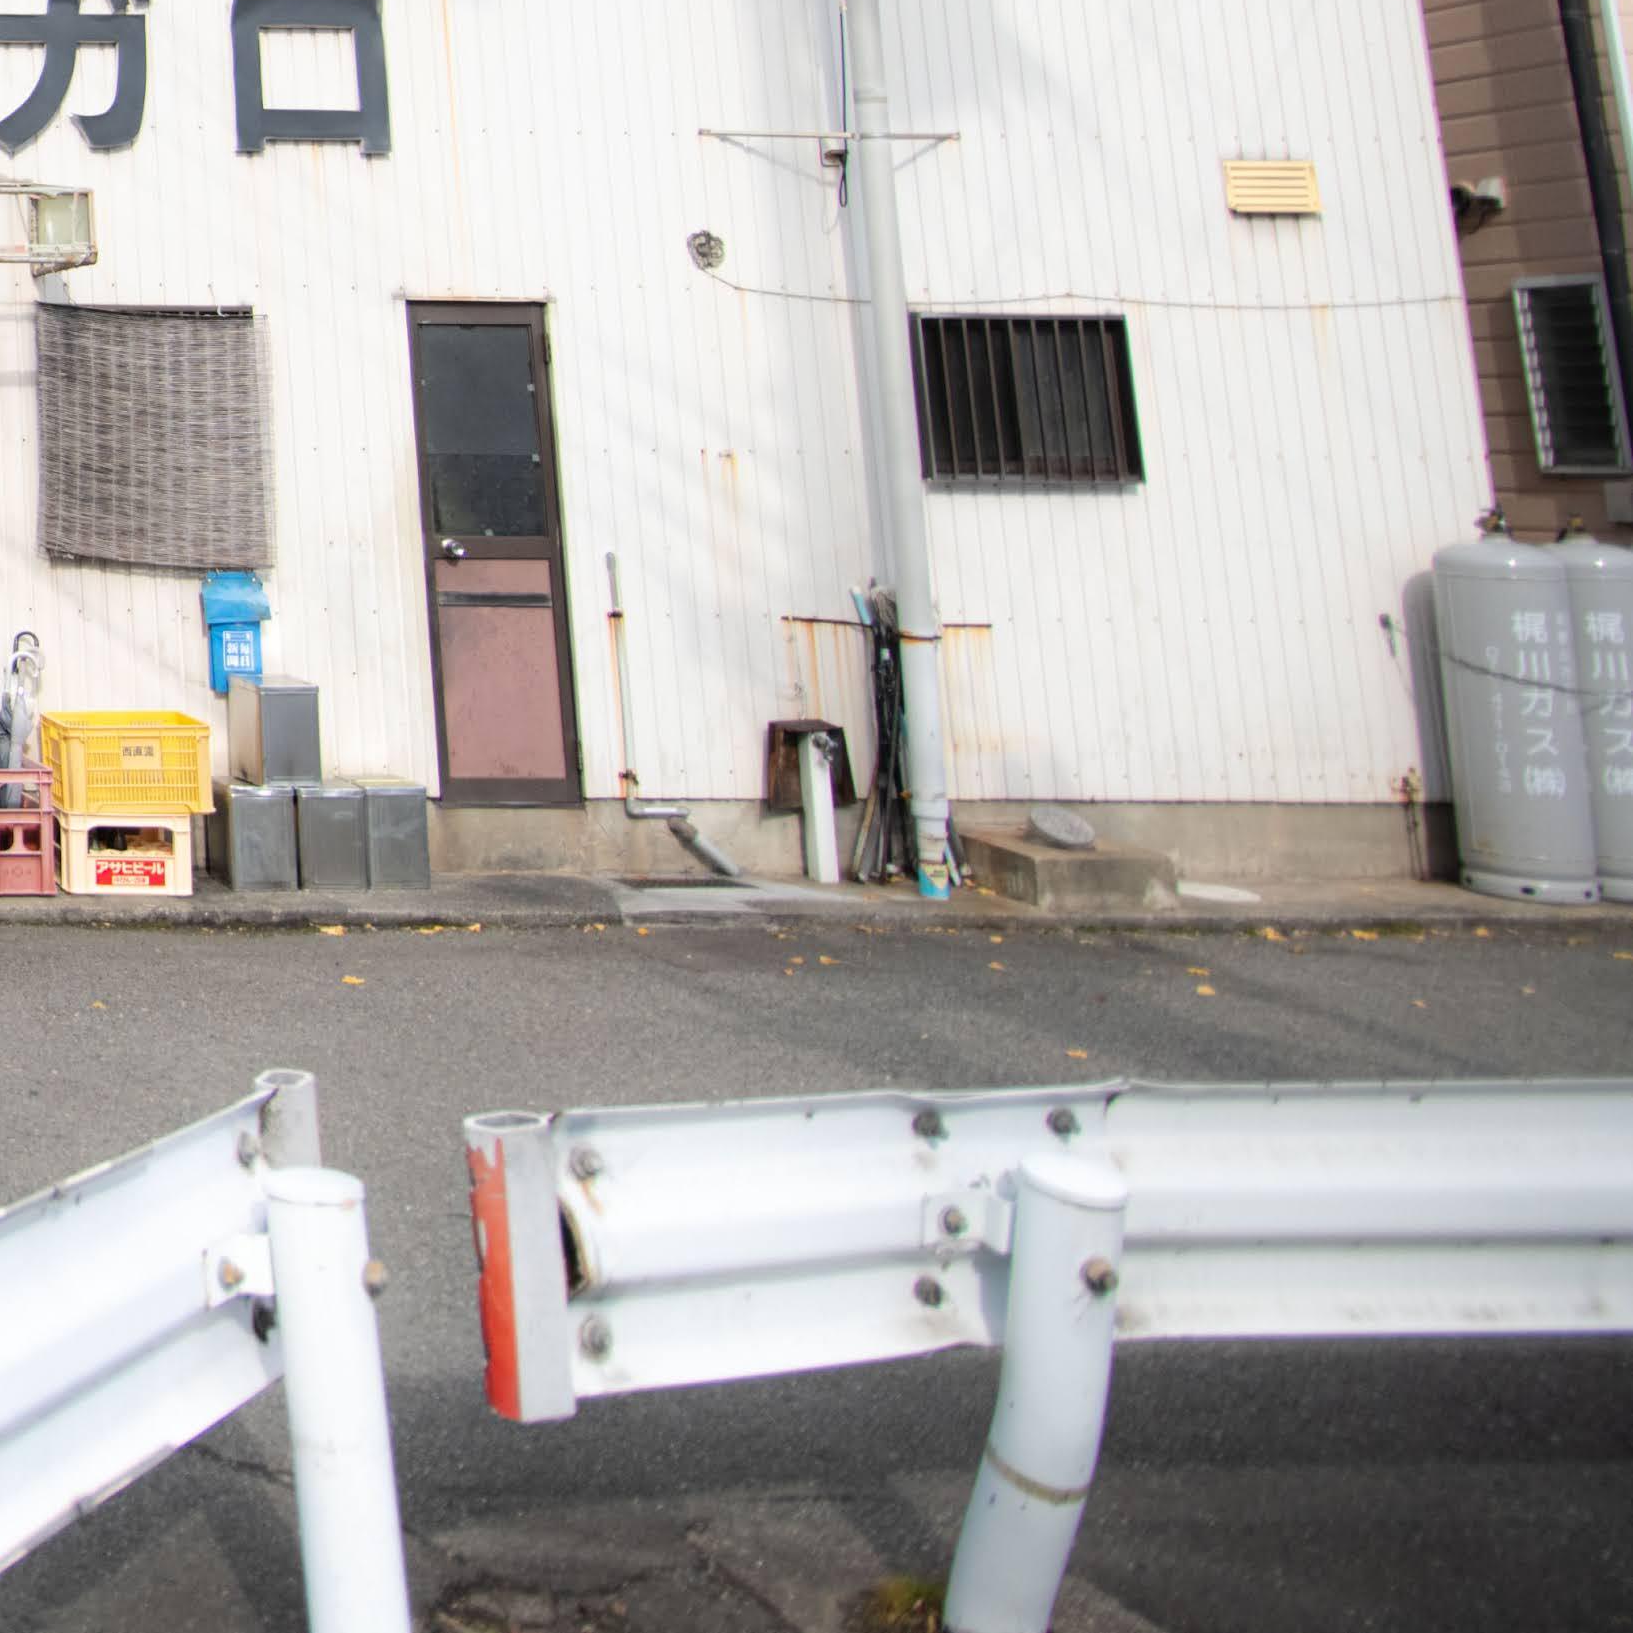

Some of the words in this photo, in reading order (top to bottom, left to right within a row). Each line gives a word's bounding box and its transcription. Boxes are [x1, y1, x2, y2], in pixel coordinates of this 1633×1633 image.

[95, 860, 165, 876] アサヒビール
